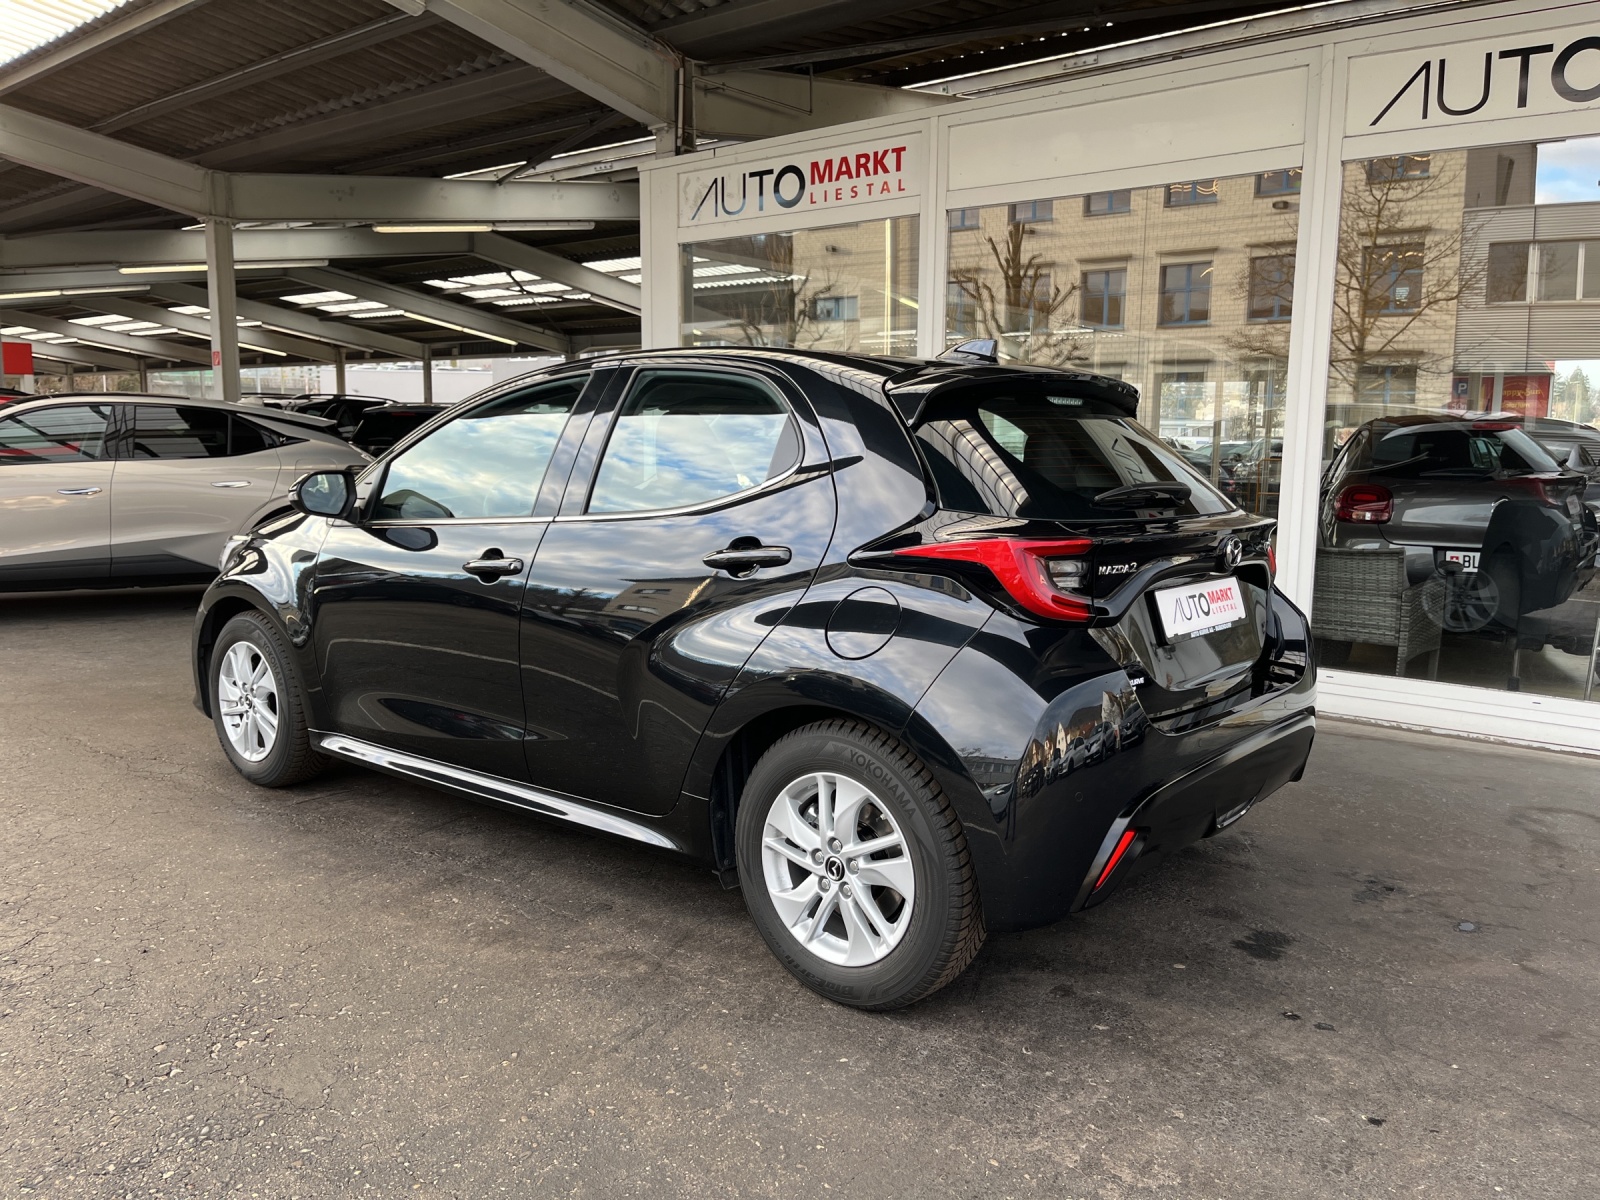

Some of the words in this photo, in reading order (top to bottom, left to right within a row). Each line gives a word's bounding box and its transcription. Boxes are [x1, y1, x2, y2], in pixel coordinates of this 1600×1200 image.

[1369, 36, 1600, 126] AUTO
[691, 164, 806, 221] AUTO
[810, 146, 907, 185] MARKT
[810, 179, 906, 204] LIESTAL
[1457, 383, 1467, 394] P
[1173, 592, 1211, 624] AUTO
[1207, 587, 1233, 605] MARKT
[1211, 602, 1238, 615] LIESTAL
[849, 749, 917, 819] YOKOHAMA
